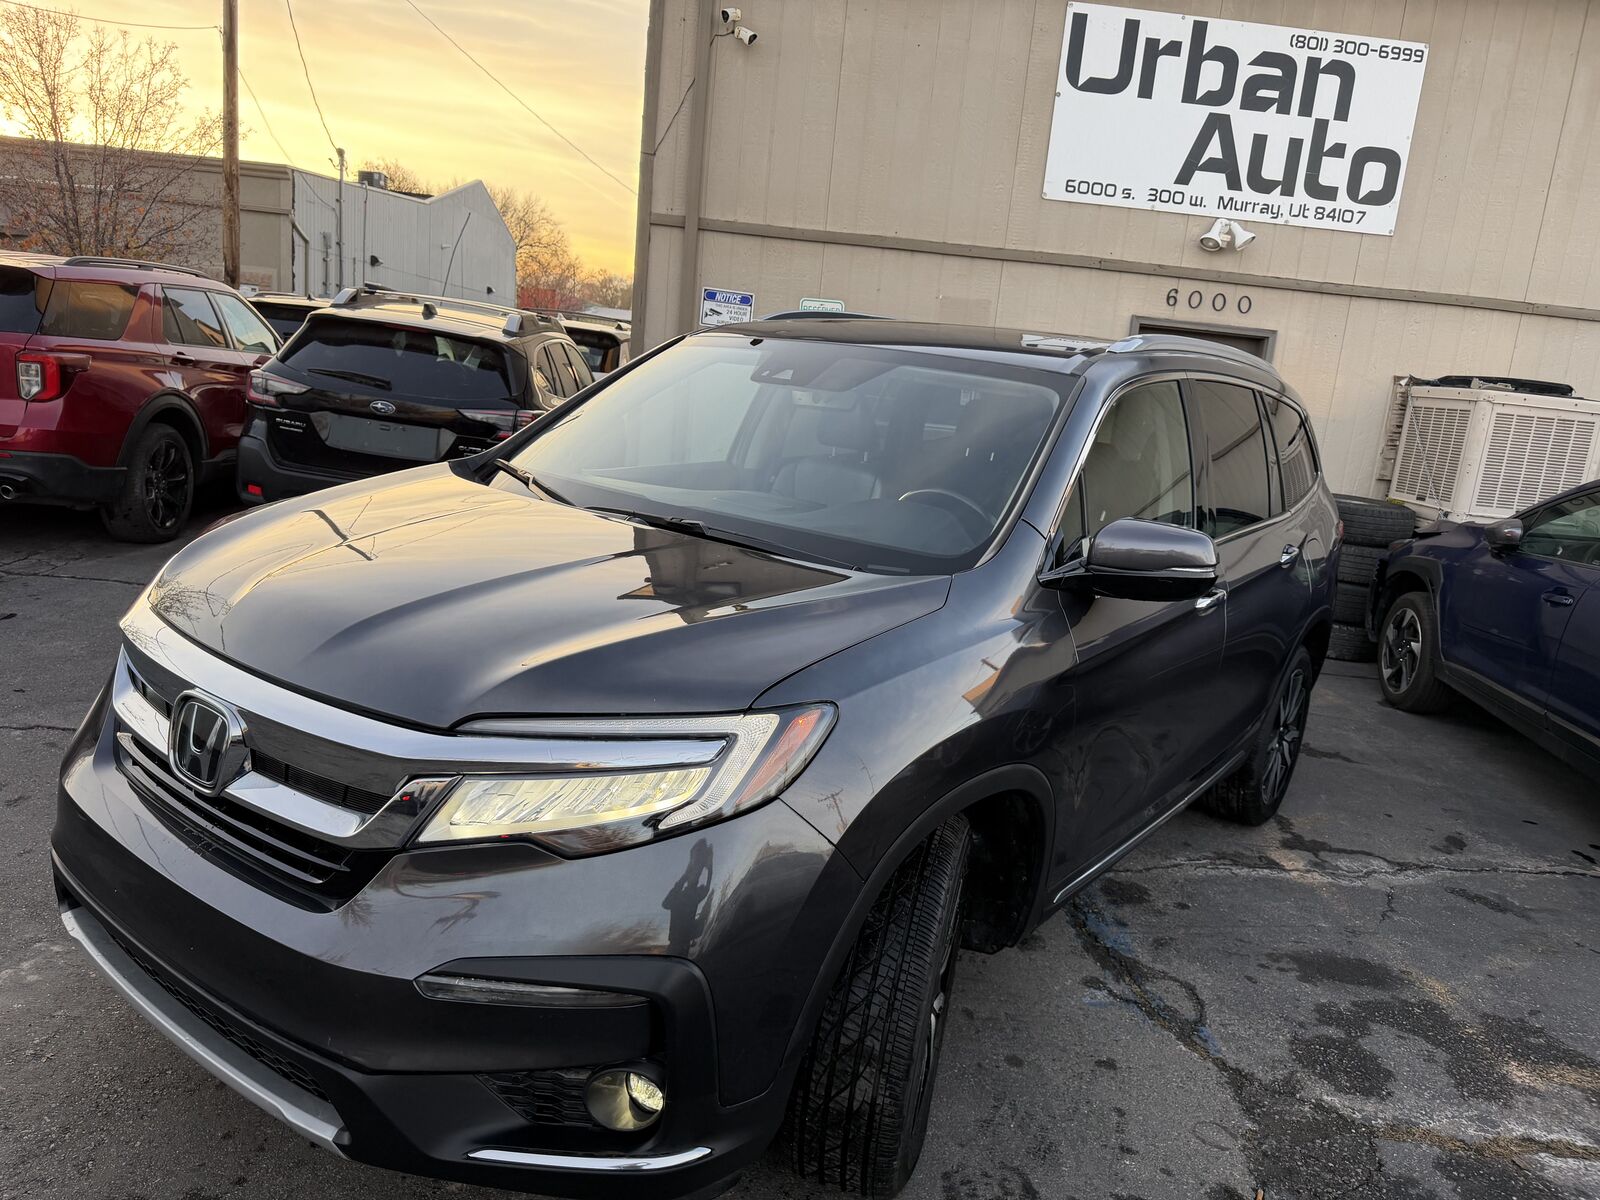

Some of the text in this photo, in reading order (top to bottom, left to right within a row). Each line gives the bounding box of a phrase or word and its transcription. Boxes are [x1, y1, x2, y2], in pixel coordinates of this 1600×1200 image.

[1289, 34, 1425, 63] (801) 300-6999
[1065, 11, 1356, 122] Urban
[1173, 111, 1402, 206] Auto
[1065, 179, 1117, 198] 6000
[1147, 187, 1185, 205] 300
[1217, 195, 1284, 219] Murray,
[1289, 203, 1310, 219] Ut
[1313, 206, 1367, 225] 84107
[714, 291, 742, 304] NOTICE
[1165, 288, 1252, 314] 6000
[275, 417, 307, 428] SUBARU
